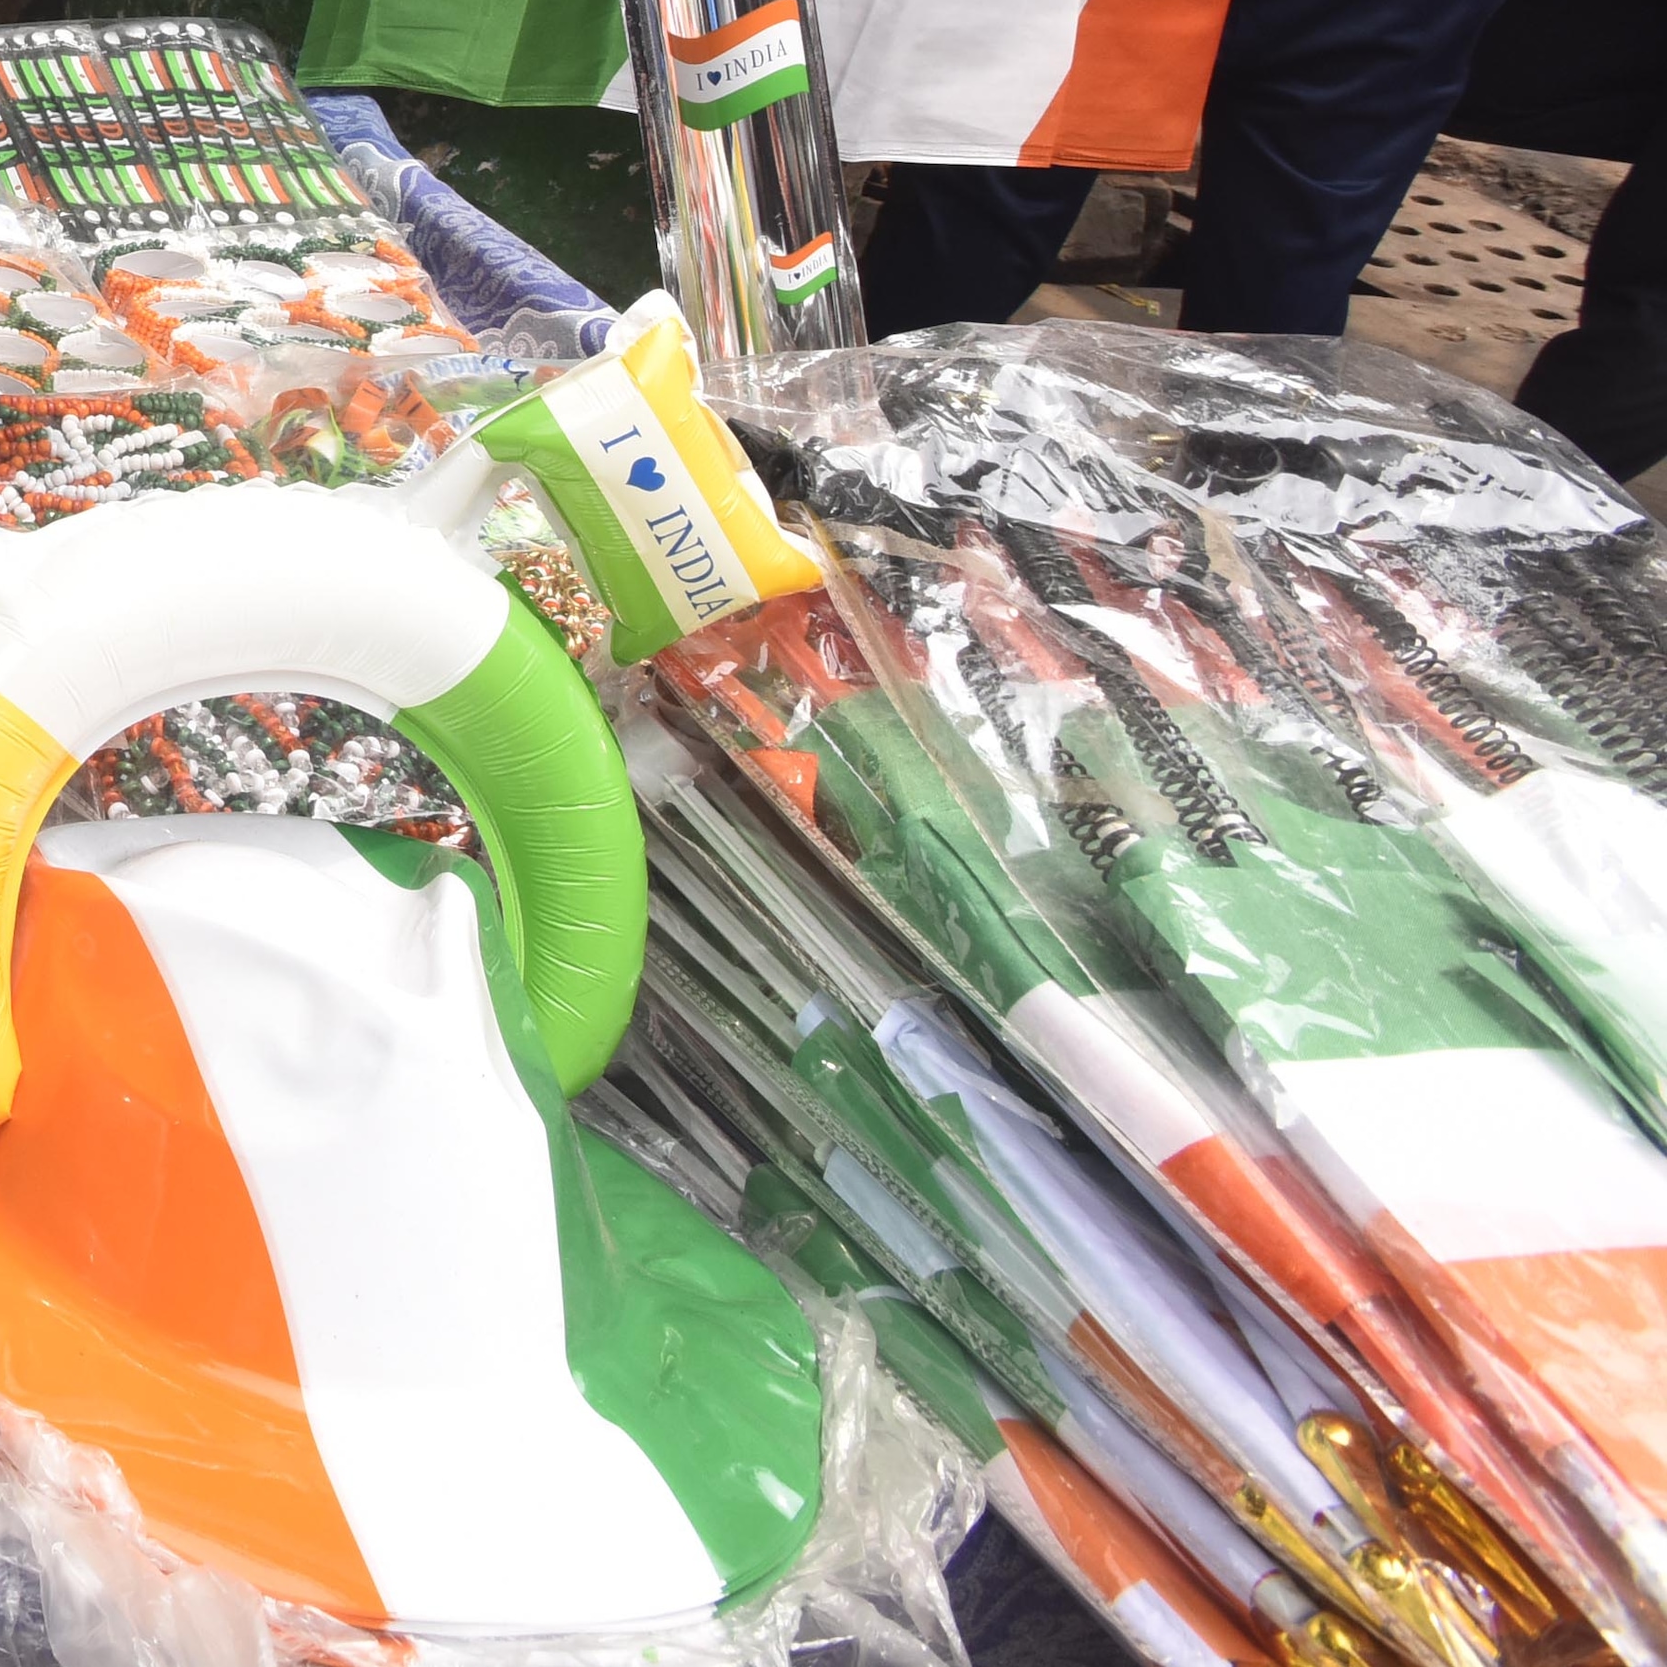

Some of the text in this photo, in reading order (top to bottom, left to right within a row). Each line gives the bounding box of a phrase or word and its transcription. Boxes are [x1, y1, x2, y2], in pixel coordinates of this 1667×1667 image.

[696, 38, 788, 92] I INDIA
[87, 94, 136, 164] INDIA
[787, 253, 830, 285] I INDIA
[598, 424, 737, 623] I INDIA
